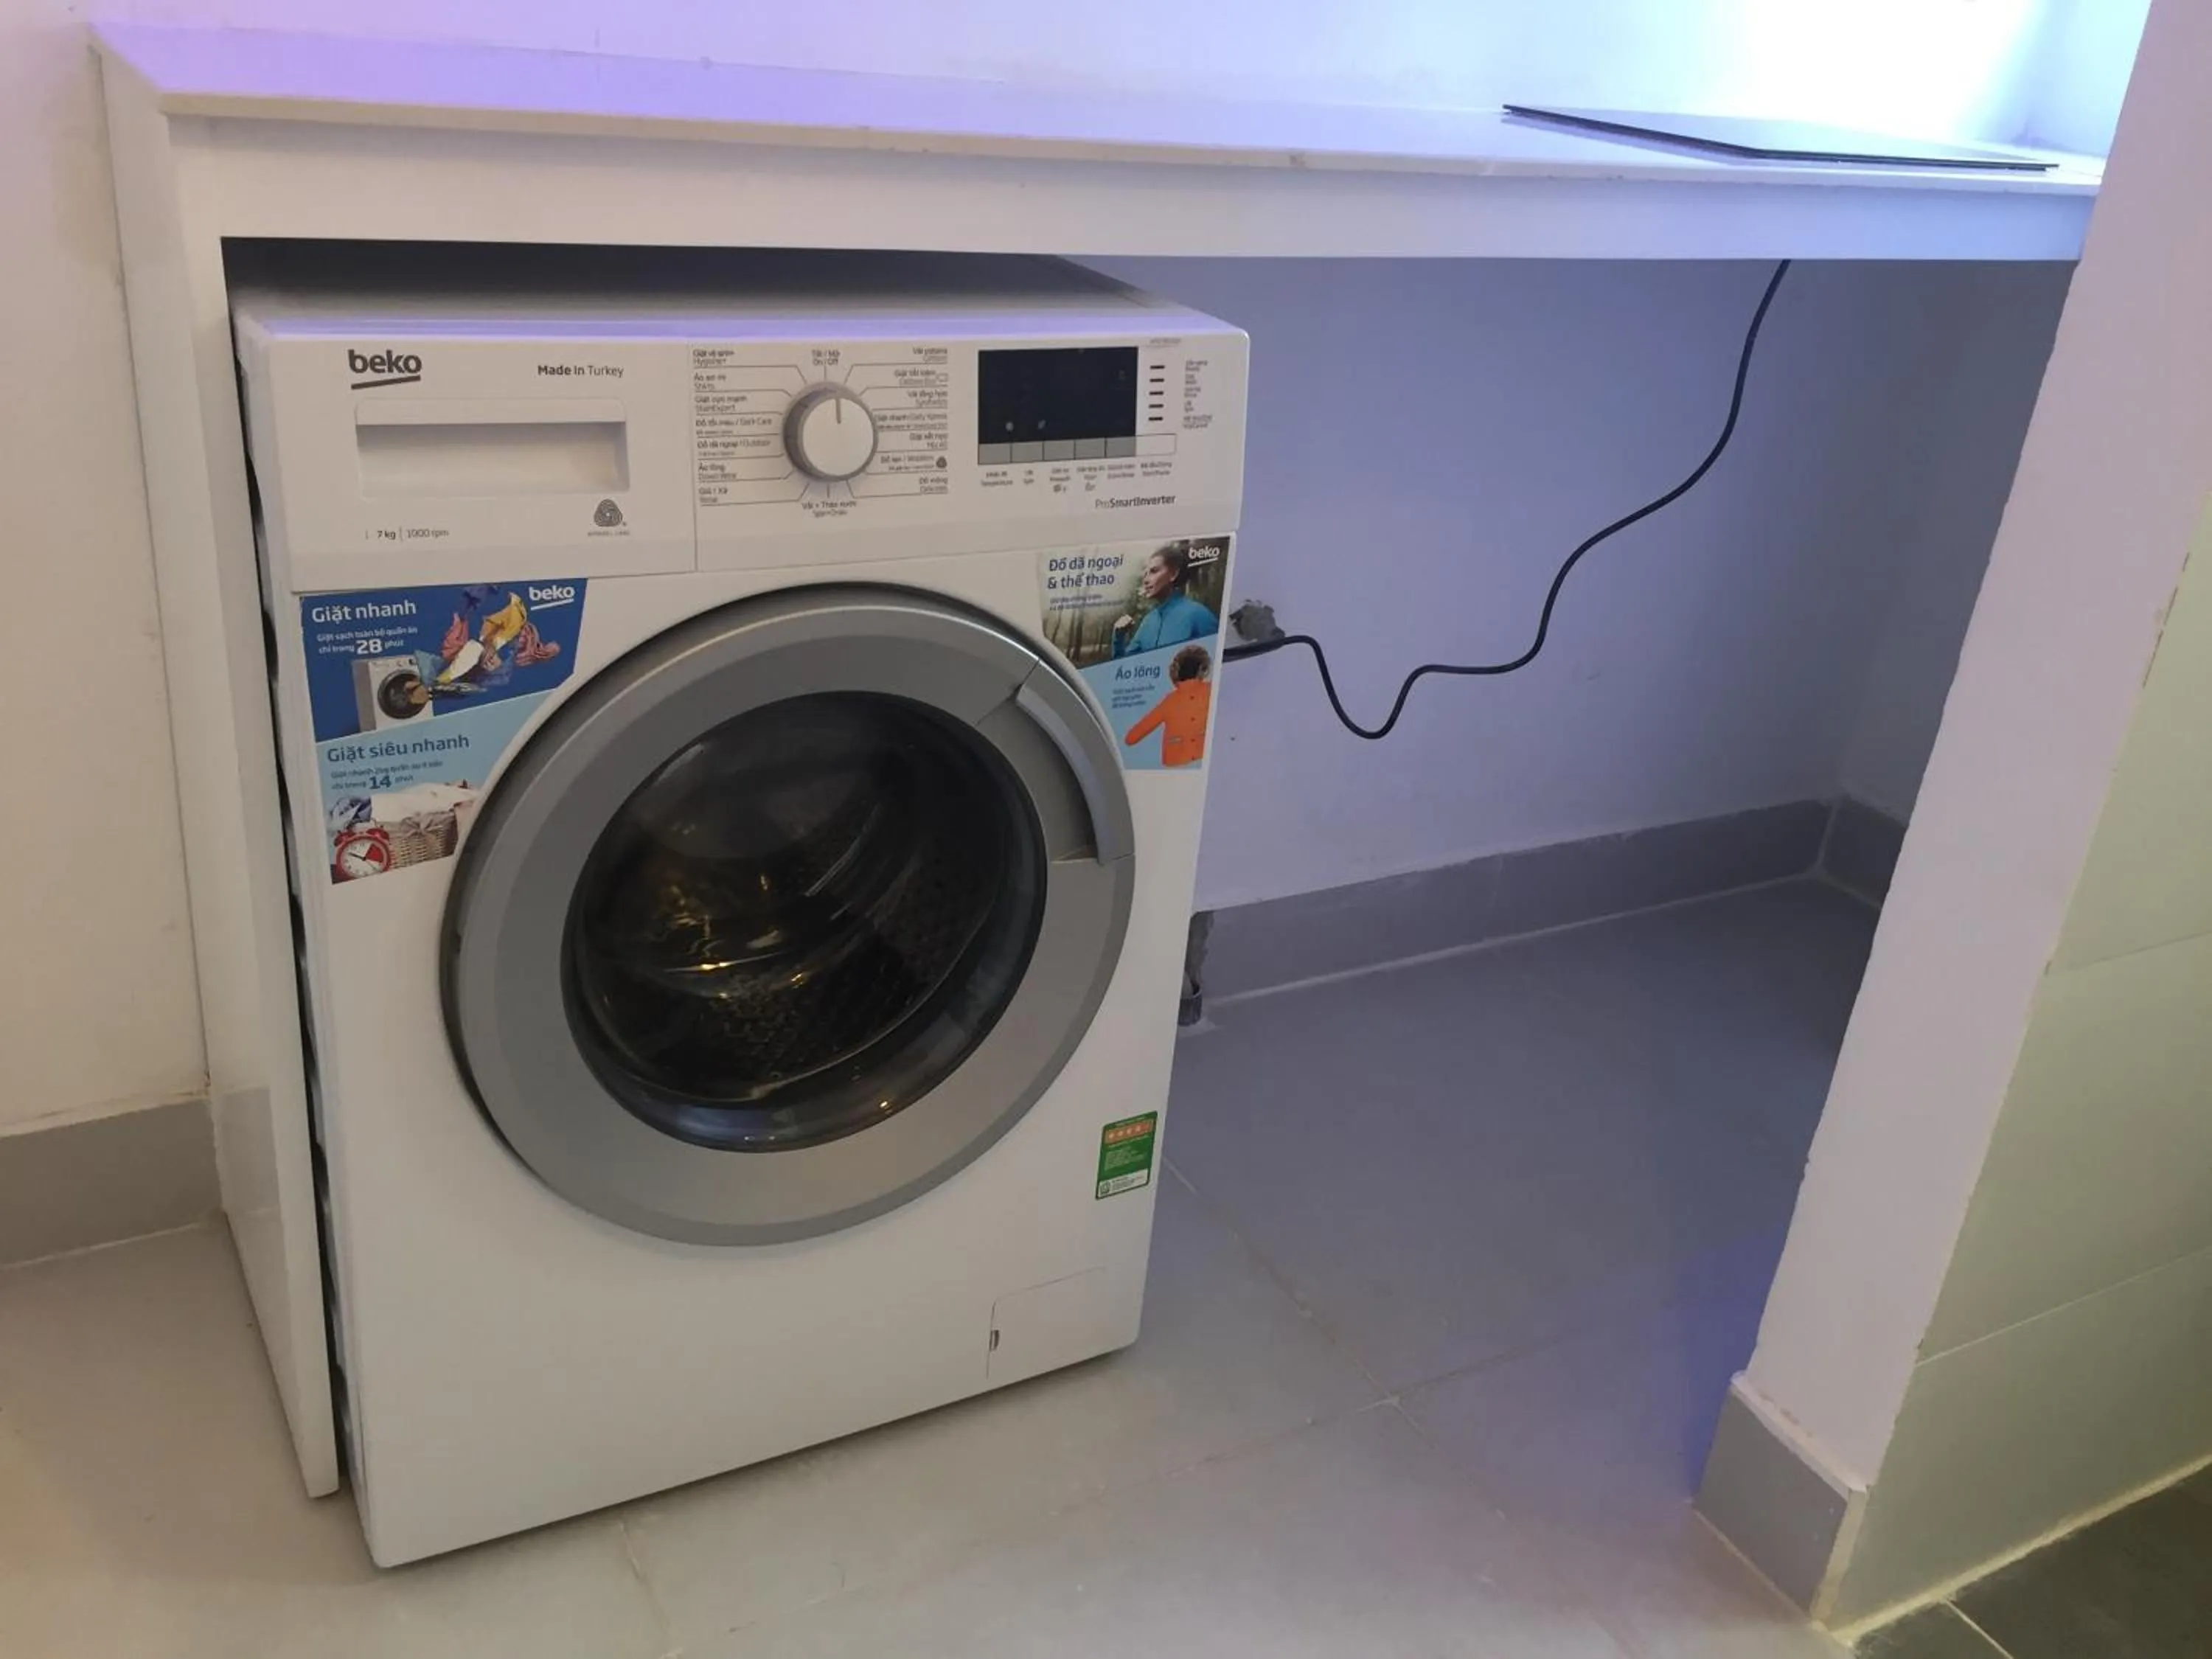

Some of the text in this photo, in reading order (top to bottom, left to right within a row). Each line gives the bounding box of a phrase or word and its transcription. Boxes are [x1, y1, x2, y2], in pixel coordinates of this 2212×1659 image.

[348, 349, 422, 374] beko
[538, 364, 571, 375] Made
[588, 365, 624, 378] Turkey
[377, 530, 383, 539] 7
[384, 530, 396, 540] kg
[1189, 546, 1220, 560] beko
[1048, 576, 1057, 589] &
[1085, 573, 1115, 586] thao
[529, 585, 575, 601] beko
[312, 599, 417, 624] Giặt nhanh
[356, 639, 383, 655] 28
[328, 734, 470, 763] Giặt siêu nhanh
[369, 775, 392, 790] 14
